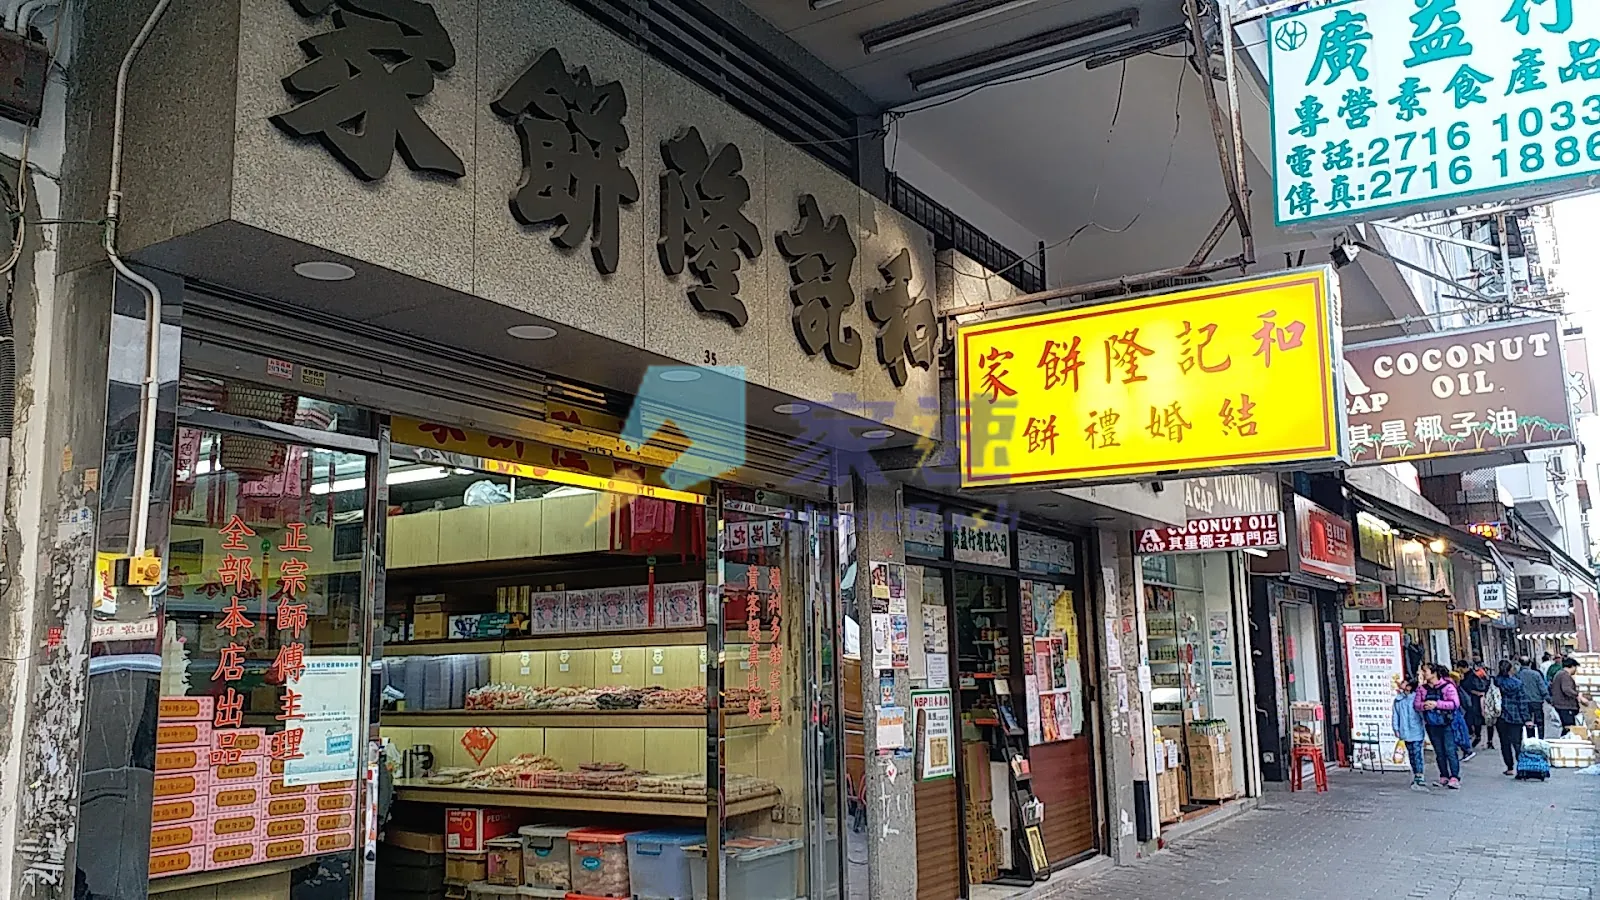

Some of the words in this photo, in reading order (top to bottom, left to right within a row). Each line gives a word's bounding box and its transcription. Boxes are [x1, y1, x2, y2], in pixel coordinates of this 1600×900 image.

[1288, 38, 1600, 138] 專營素食產品
[1492, 94, 1600, 142] 1033
[703, 350, 717, 366] 35
[1373, 332, 1551, 378] COCONUT
[1348, 406, 1518, 448] 其星椰子油
[1185, 482, 1214, 514] ACAP
[1167, 516, 1242, 535] CONUT
[1248, 514, 1277, 530] OIL
[1168, 530, 1278, 550] 其星椰子專門店
[1138, 541, 1166, 553] ACAP
[208, 514, 256, 765] 全部本店出品
[271, 522, 312, 760] 正宗師傅主理
[1354, 634, 1394, 646] 金泰皇
